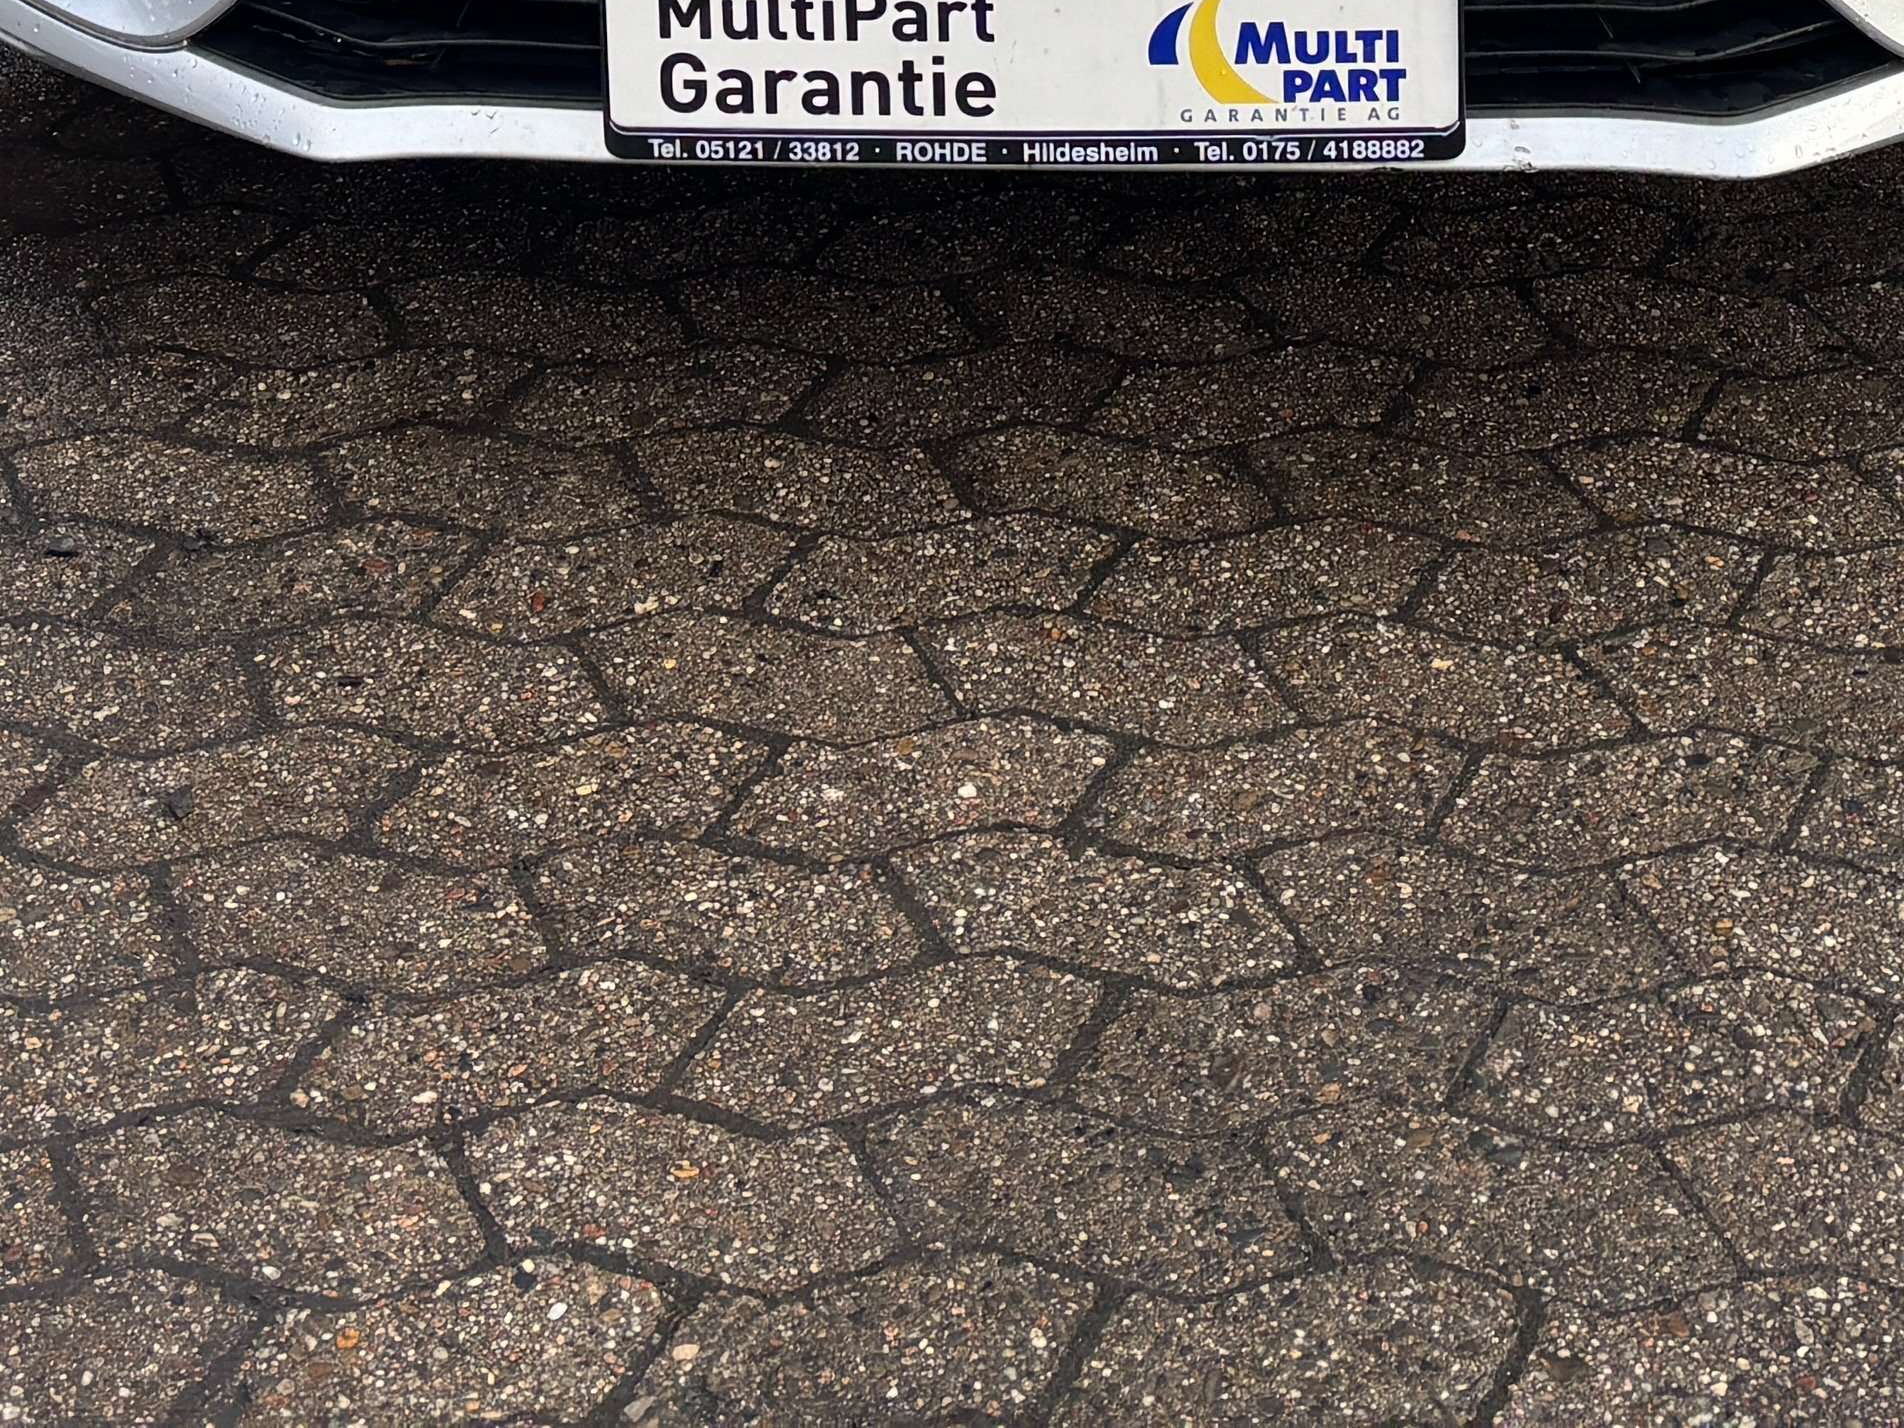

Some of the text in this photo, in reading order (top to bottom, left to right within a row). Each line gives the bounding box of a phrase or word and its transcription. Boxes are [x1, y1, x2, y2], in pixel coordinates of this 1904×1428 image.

[659, 52, 997, 118] Garantie
[1282, 68, 1407, 103] PART
[1180, 106, 1401, 123] GARANTIE AG
[648, 138, 688, 159] Tel.
[696, 140, 764, 160] 05121
[789, 141, 860, 162] 33812
[896, 142, 988, 163] ROHDE
[1023, 141, 1159, 163] Hildesheim
[1194, 142, 1235, 162] Tel.
[1243, 141, 1300, 161] 0175
[1323, 139, 1426, 160] 4188882
